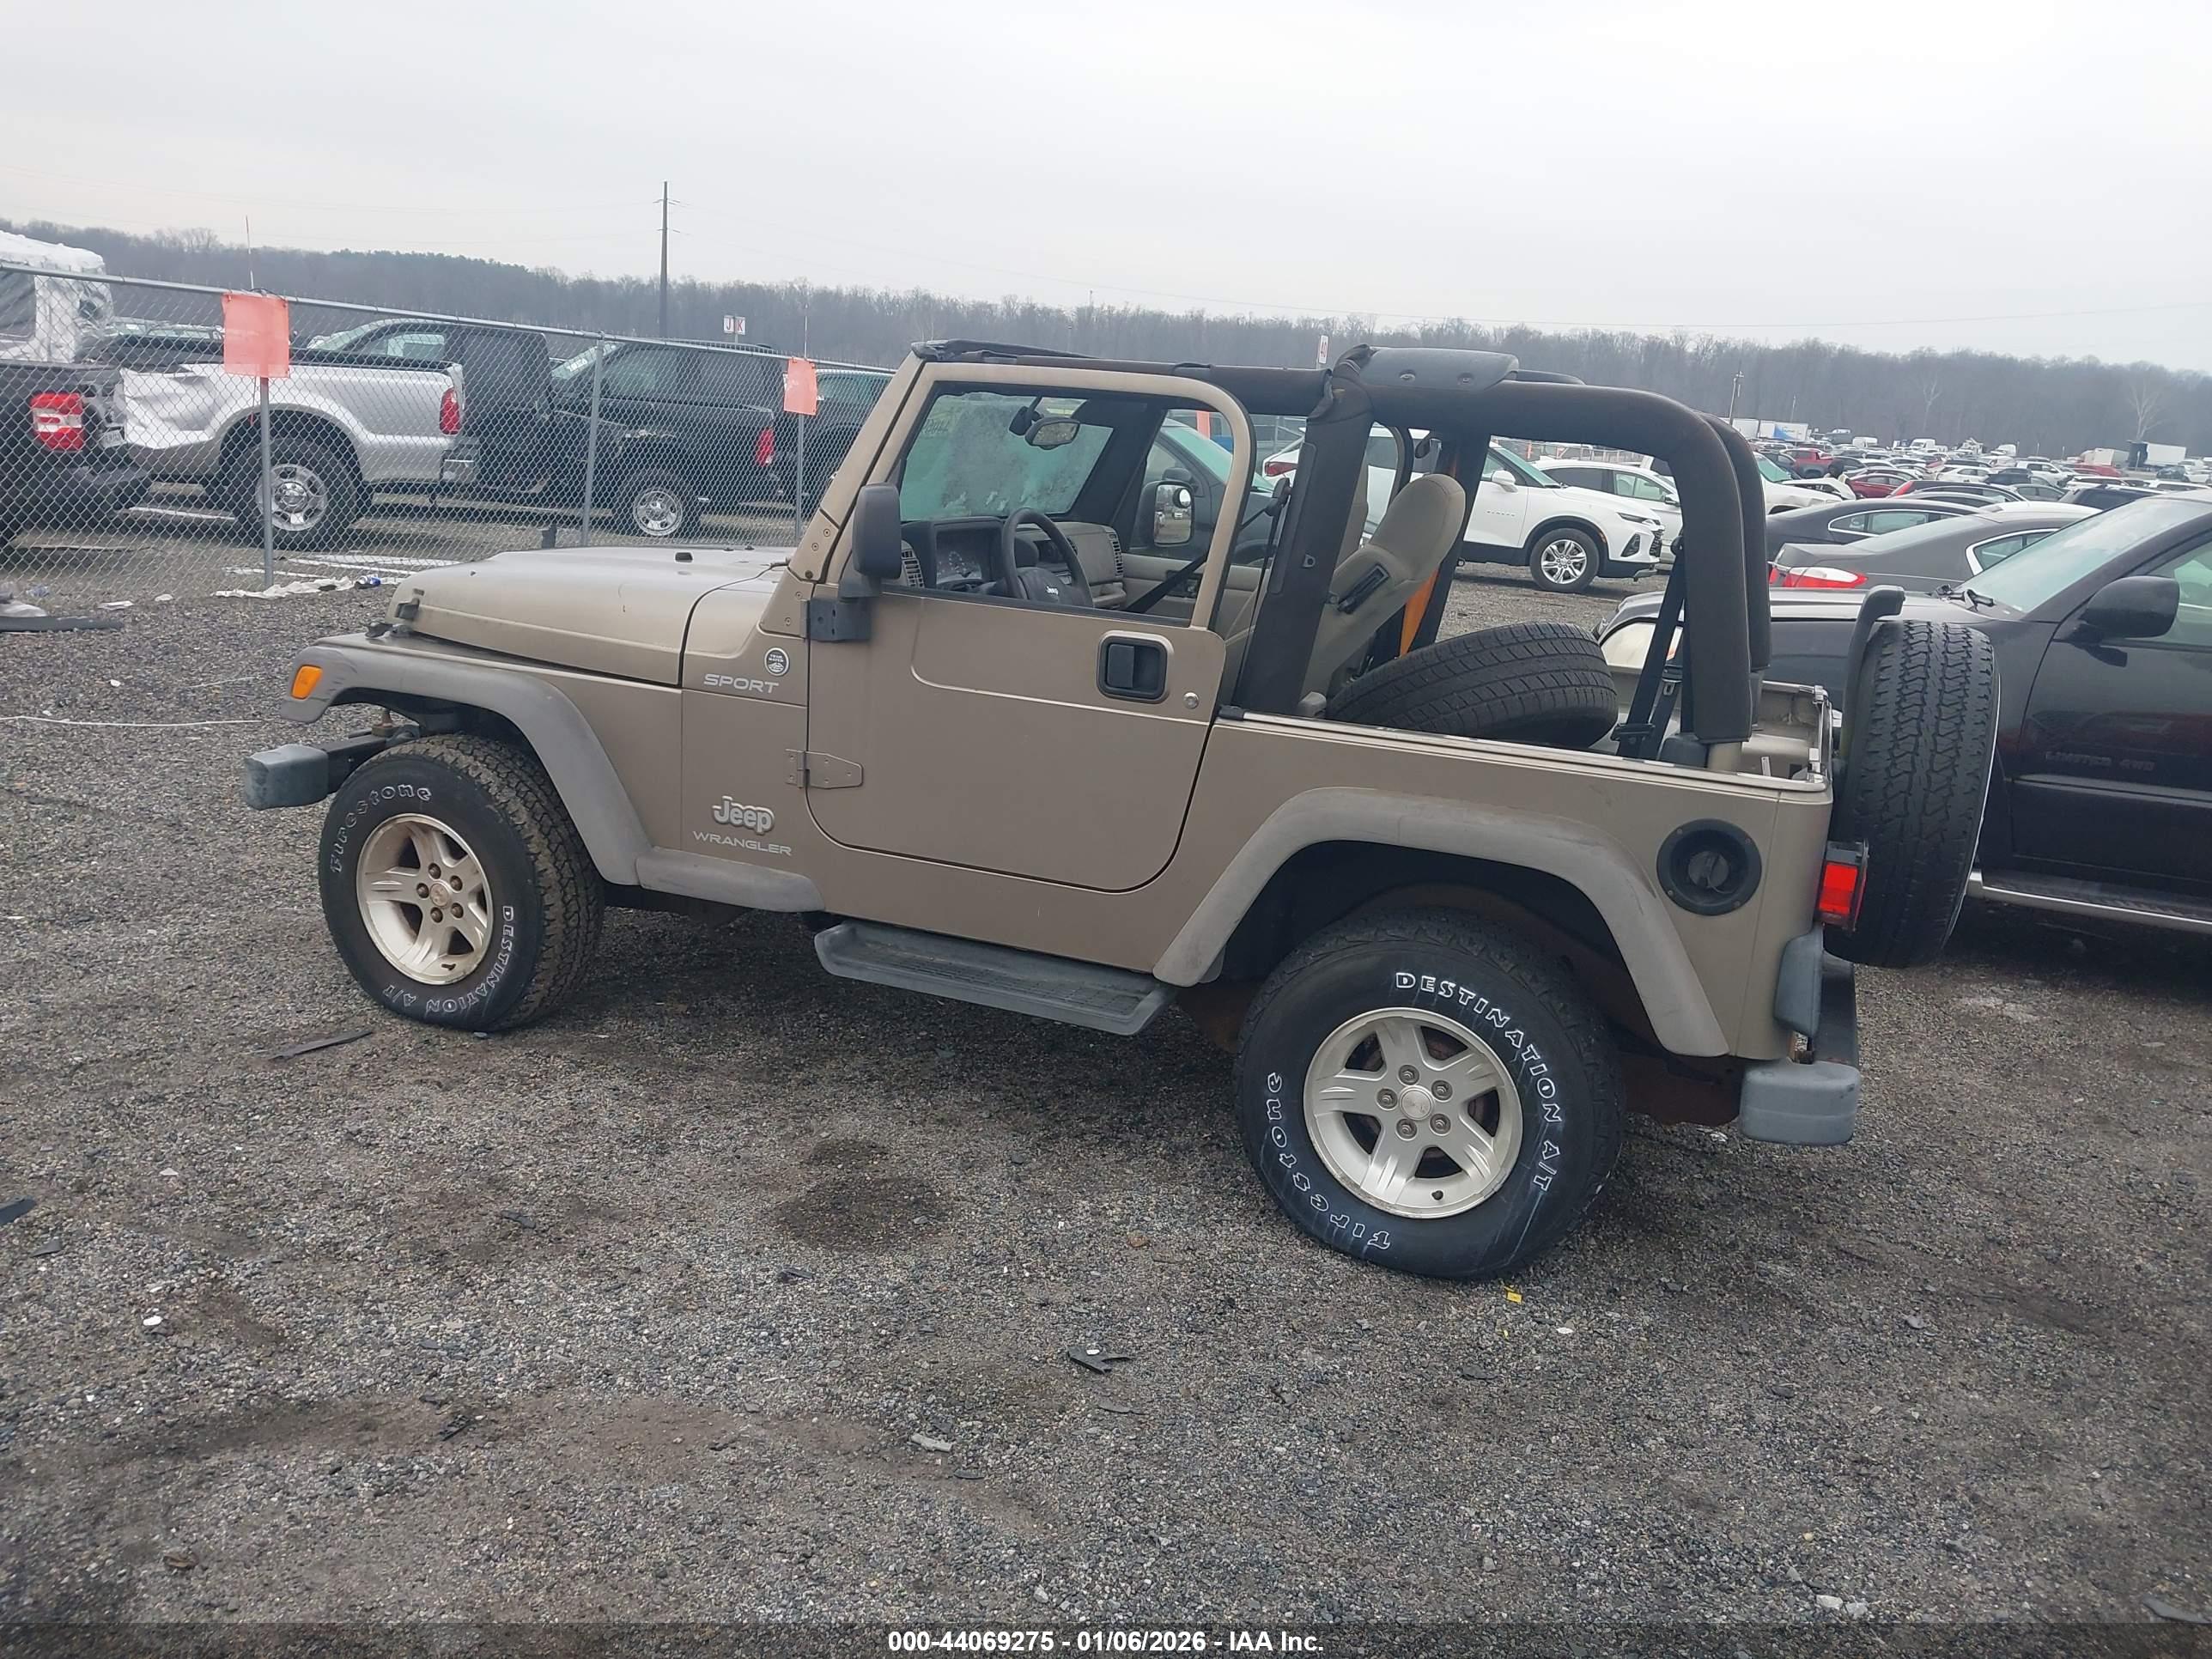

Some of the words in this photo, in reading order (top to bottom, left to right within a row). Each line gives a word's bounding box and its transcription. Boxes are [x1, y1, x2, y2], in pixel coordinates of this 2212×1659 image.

[703, 673, 780, 694] SPORT
[329, 783, 432, 873] Firestone
[692, 830, 793, 856] WRANGLER
[711, 795, 775, 836] Jeep
[425, 905, 514, 1014] DESTINATION
[383, 985, 416, 1007] A/T
[1395, 972, 1563, 1123] DESTINATION
[1533, 1140, 1560, 1192] A/T
[1266, 1073, 1391, 1250] Firestone
